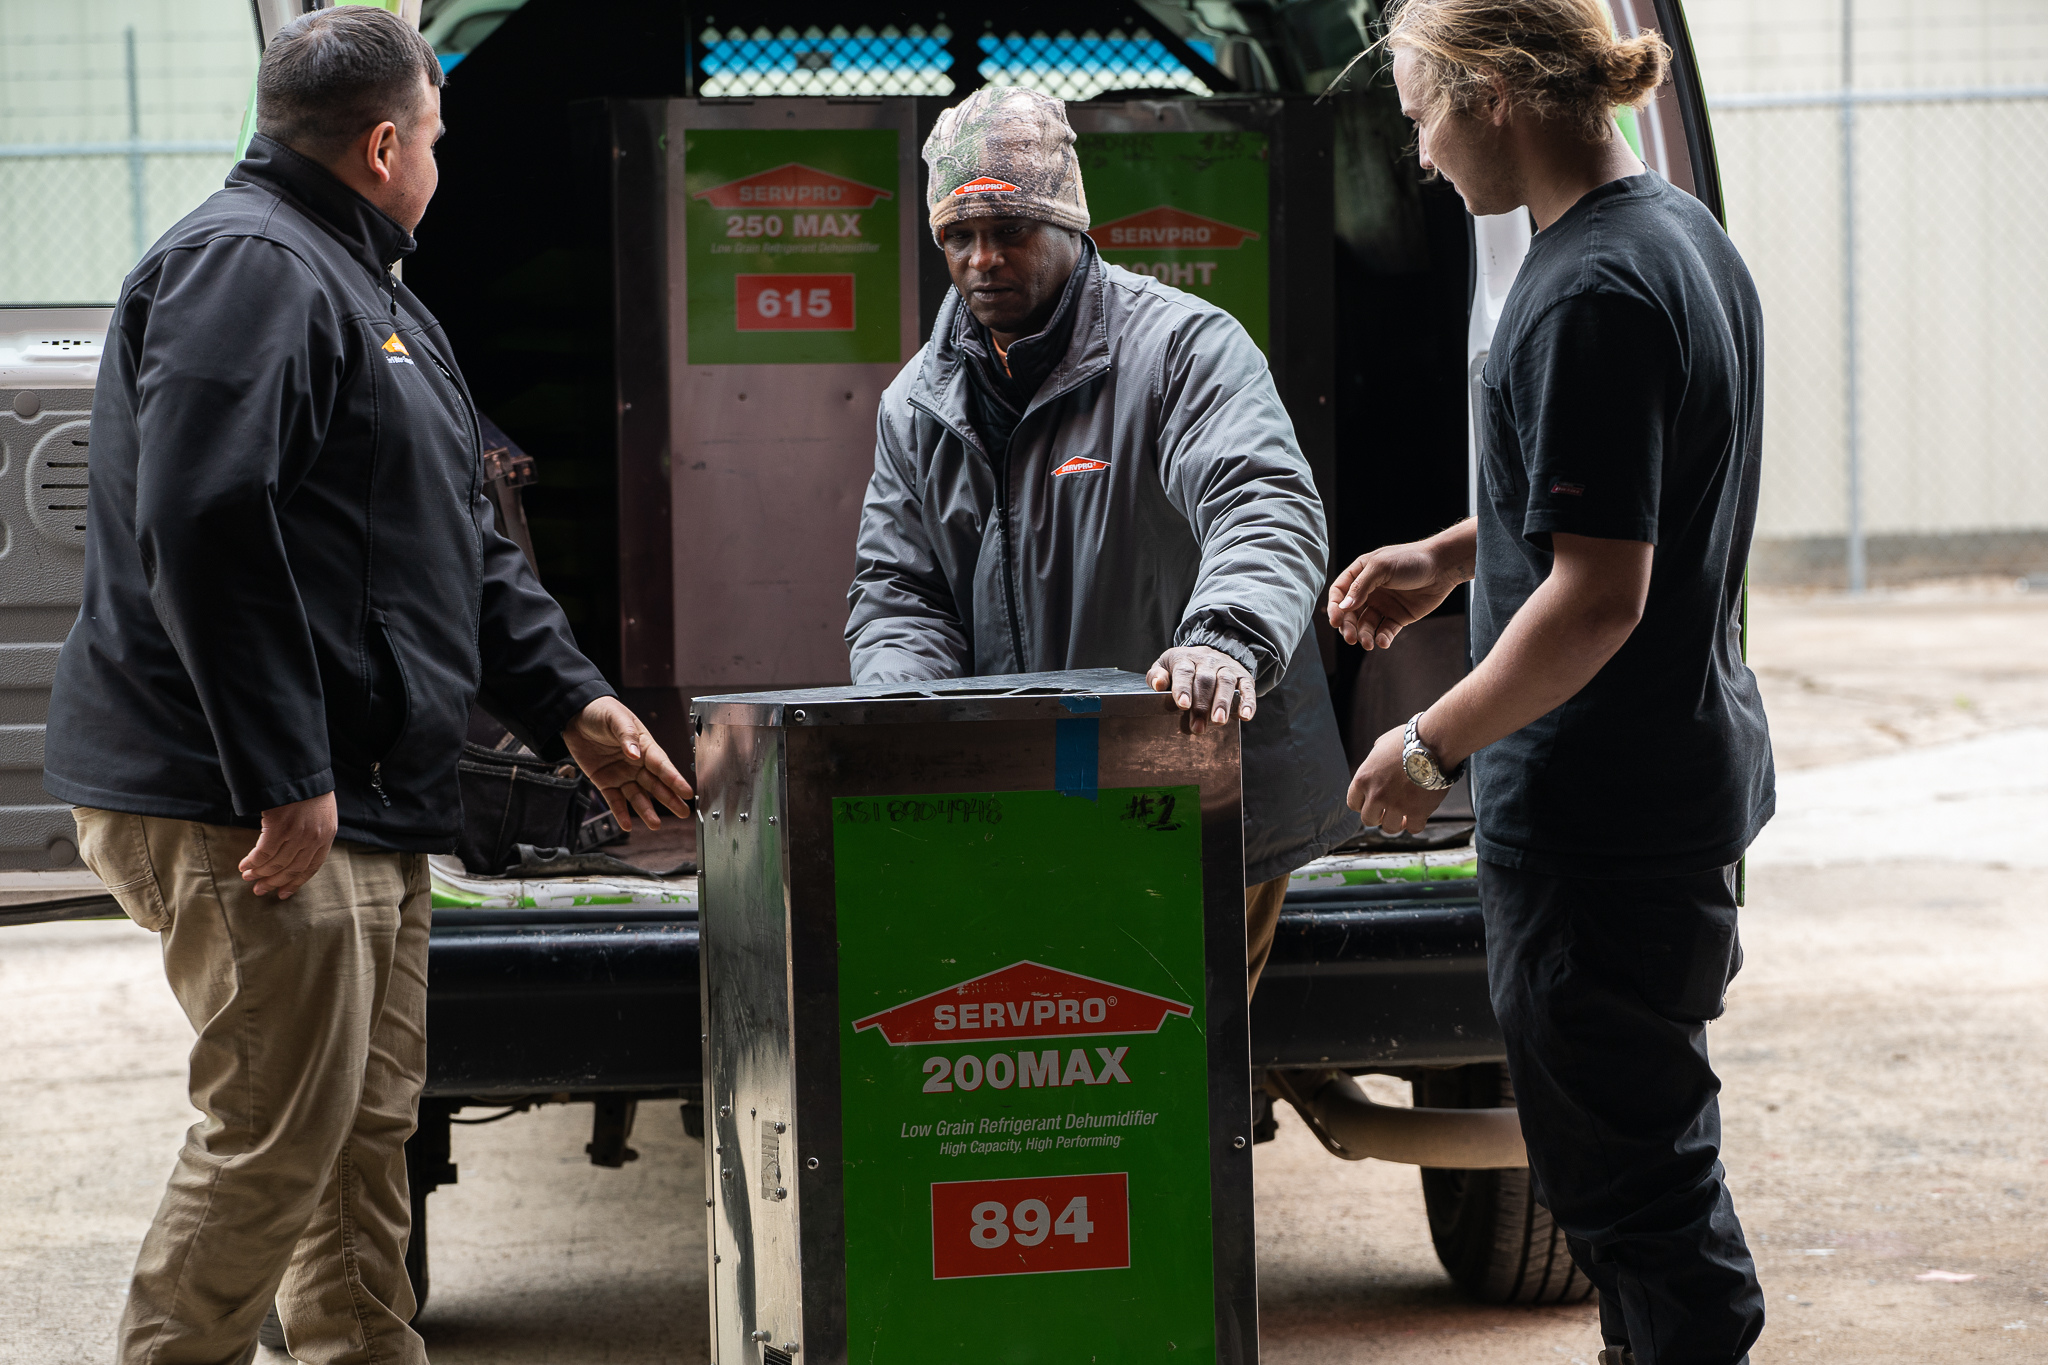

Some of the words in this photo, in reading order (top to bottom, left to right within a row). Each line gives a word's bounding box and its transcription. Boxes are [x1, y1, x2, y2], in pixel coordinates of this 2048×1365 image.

[740, 185, 843, 202] SERVPRO
[726, 214, 784, 238] 250
[793, 213, 862, 238] MAX
[1110, 227, 1212, 245] SERVPRO
[757, 288, 833, 318] 615
[922, 1046, 1133, 1094] 200MAX
[901, 1121, 932, 1138] Low
[936, 1120, 975, 1136] Grain
[978, 1115, 1061, 1136] Refrigerant
[1064, 1110, 1159, 1130] Dehumidifier
[939, 1142, 967, 1157] High
[970, 1139, 1023, 1156] Capacity,
[1025, 1137, 1053, 1152] High
[1056, 1134, 1122, 1149] Performing
[969, 1196, 1095, 1250] 894
